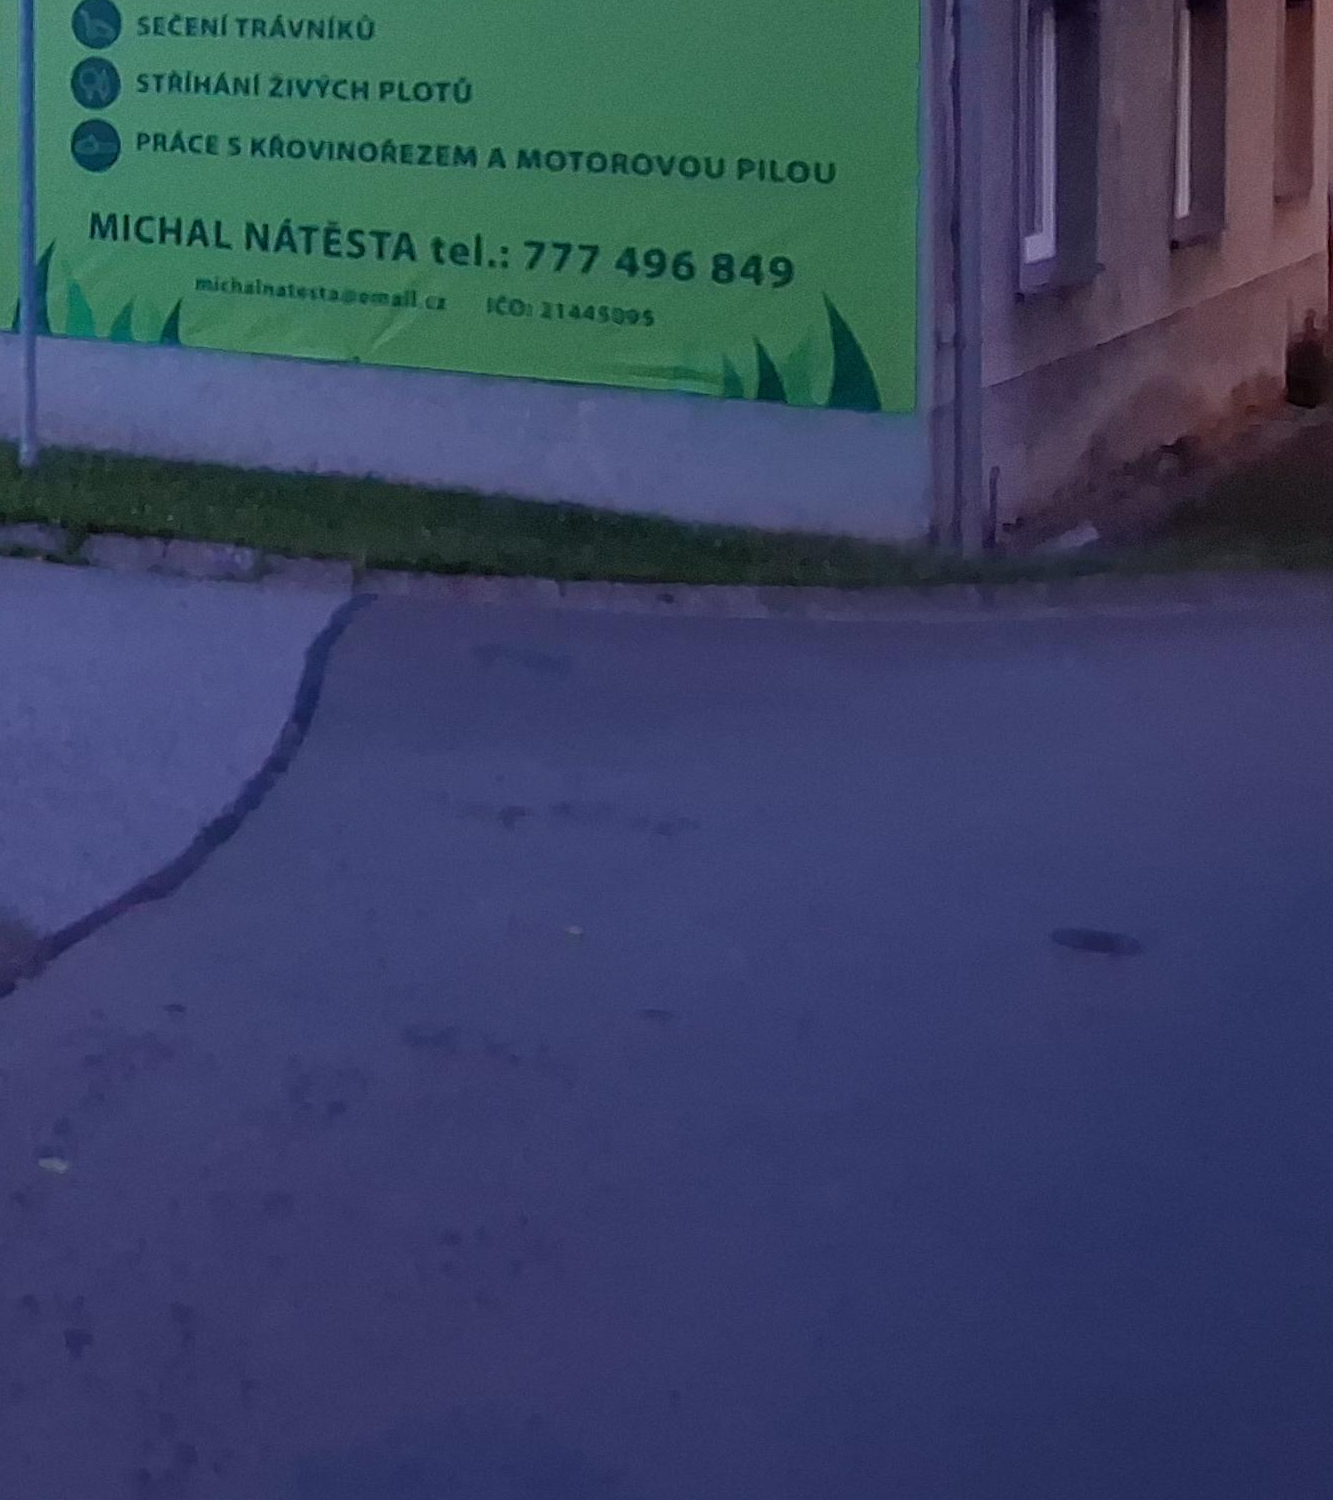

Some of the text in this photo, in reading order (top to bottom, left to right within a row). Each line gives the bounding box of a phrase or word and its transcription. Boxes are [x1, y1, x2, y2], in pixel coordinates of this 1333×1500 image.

[136, 14, 375, 40] SEČENÍ TRÁVNÍKŮ
[136, 70, 472, 103] STŘÍHÁNÍ ŽIVÝCH PLOTŮ
[136, 131, 835, 184] PRÁCE S KŘOVINOŘEZEM A MOTOROVOU PILOU
[88, 211, 794, 288] MICHAL NÁTĚSTA tel.: 777 496 849
